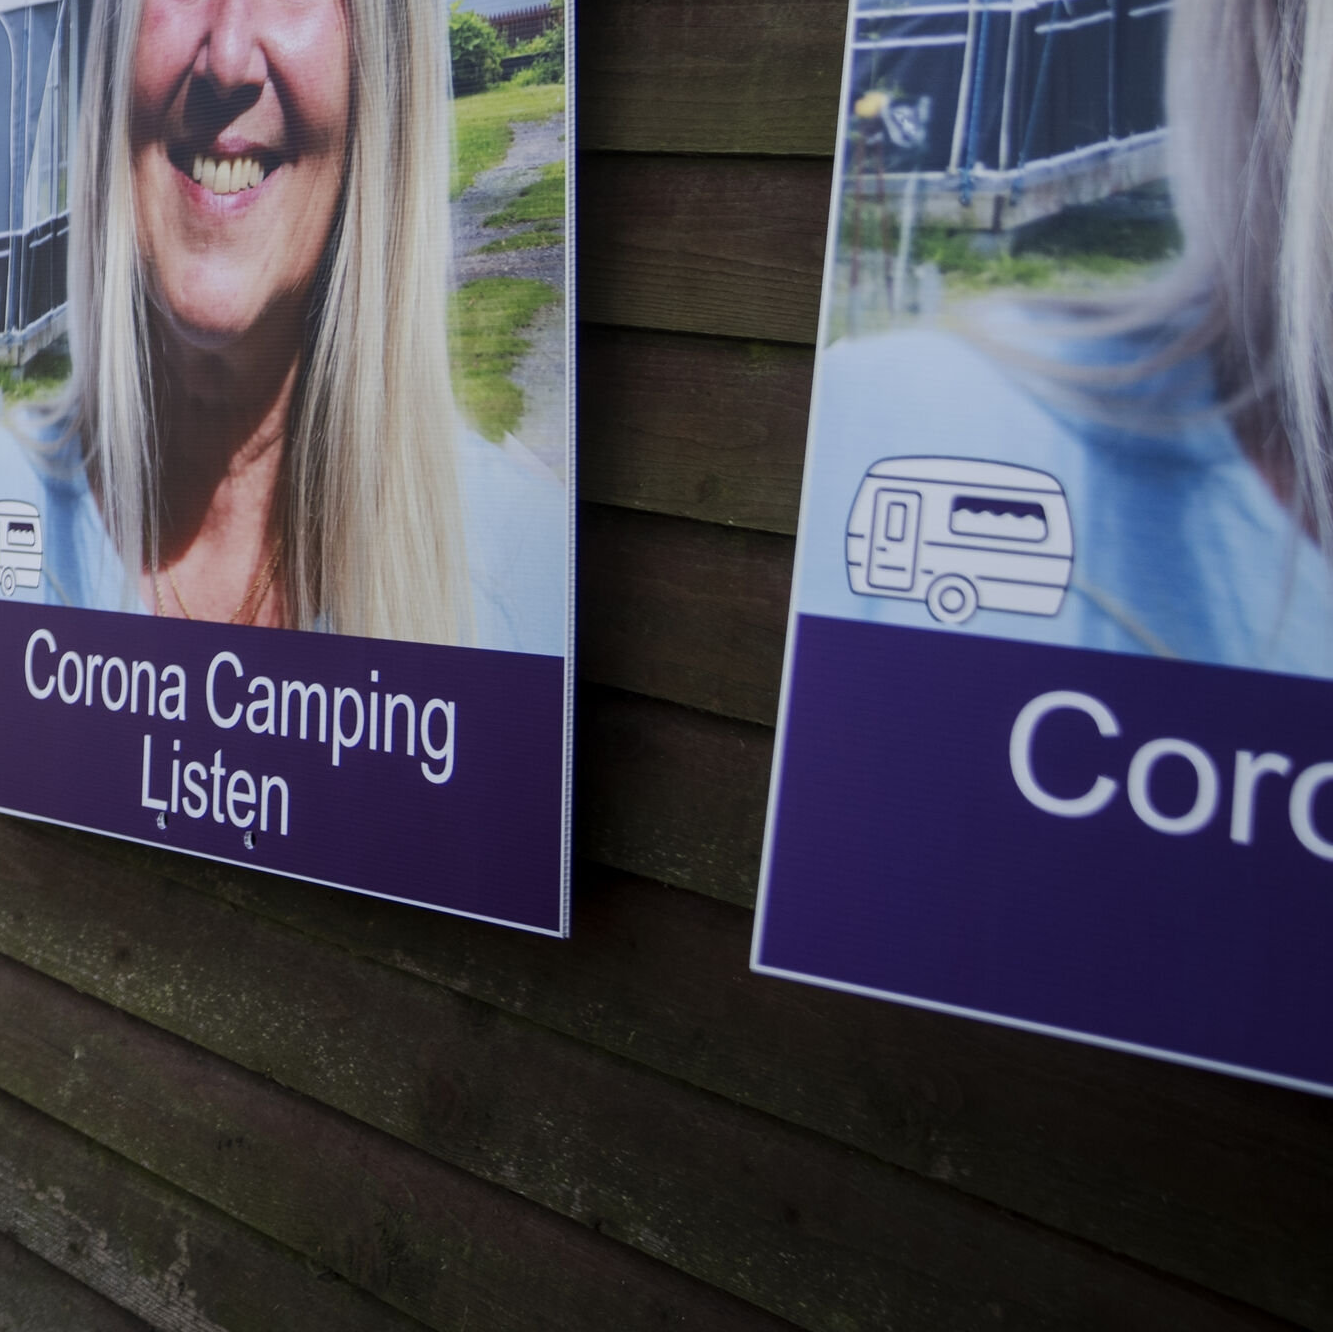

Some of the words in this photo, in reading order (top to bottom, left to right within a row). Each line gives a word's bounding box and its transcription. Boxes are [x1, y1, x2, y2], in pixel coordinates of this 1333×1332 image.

[24, 628, 187, 721] Corona
[205, 651, 456, 785] Camping
[140, 734, 290, 836] Listen
